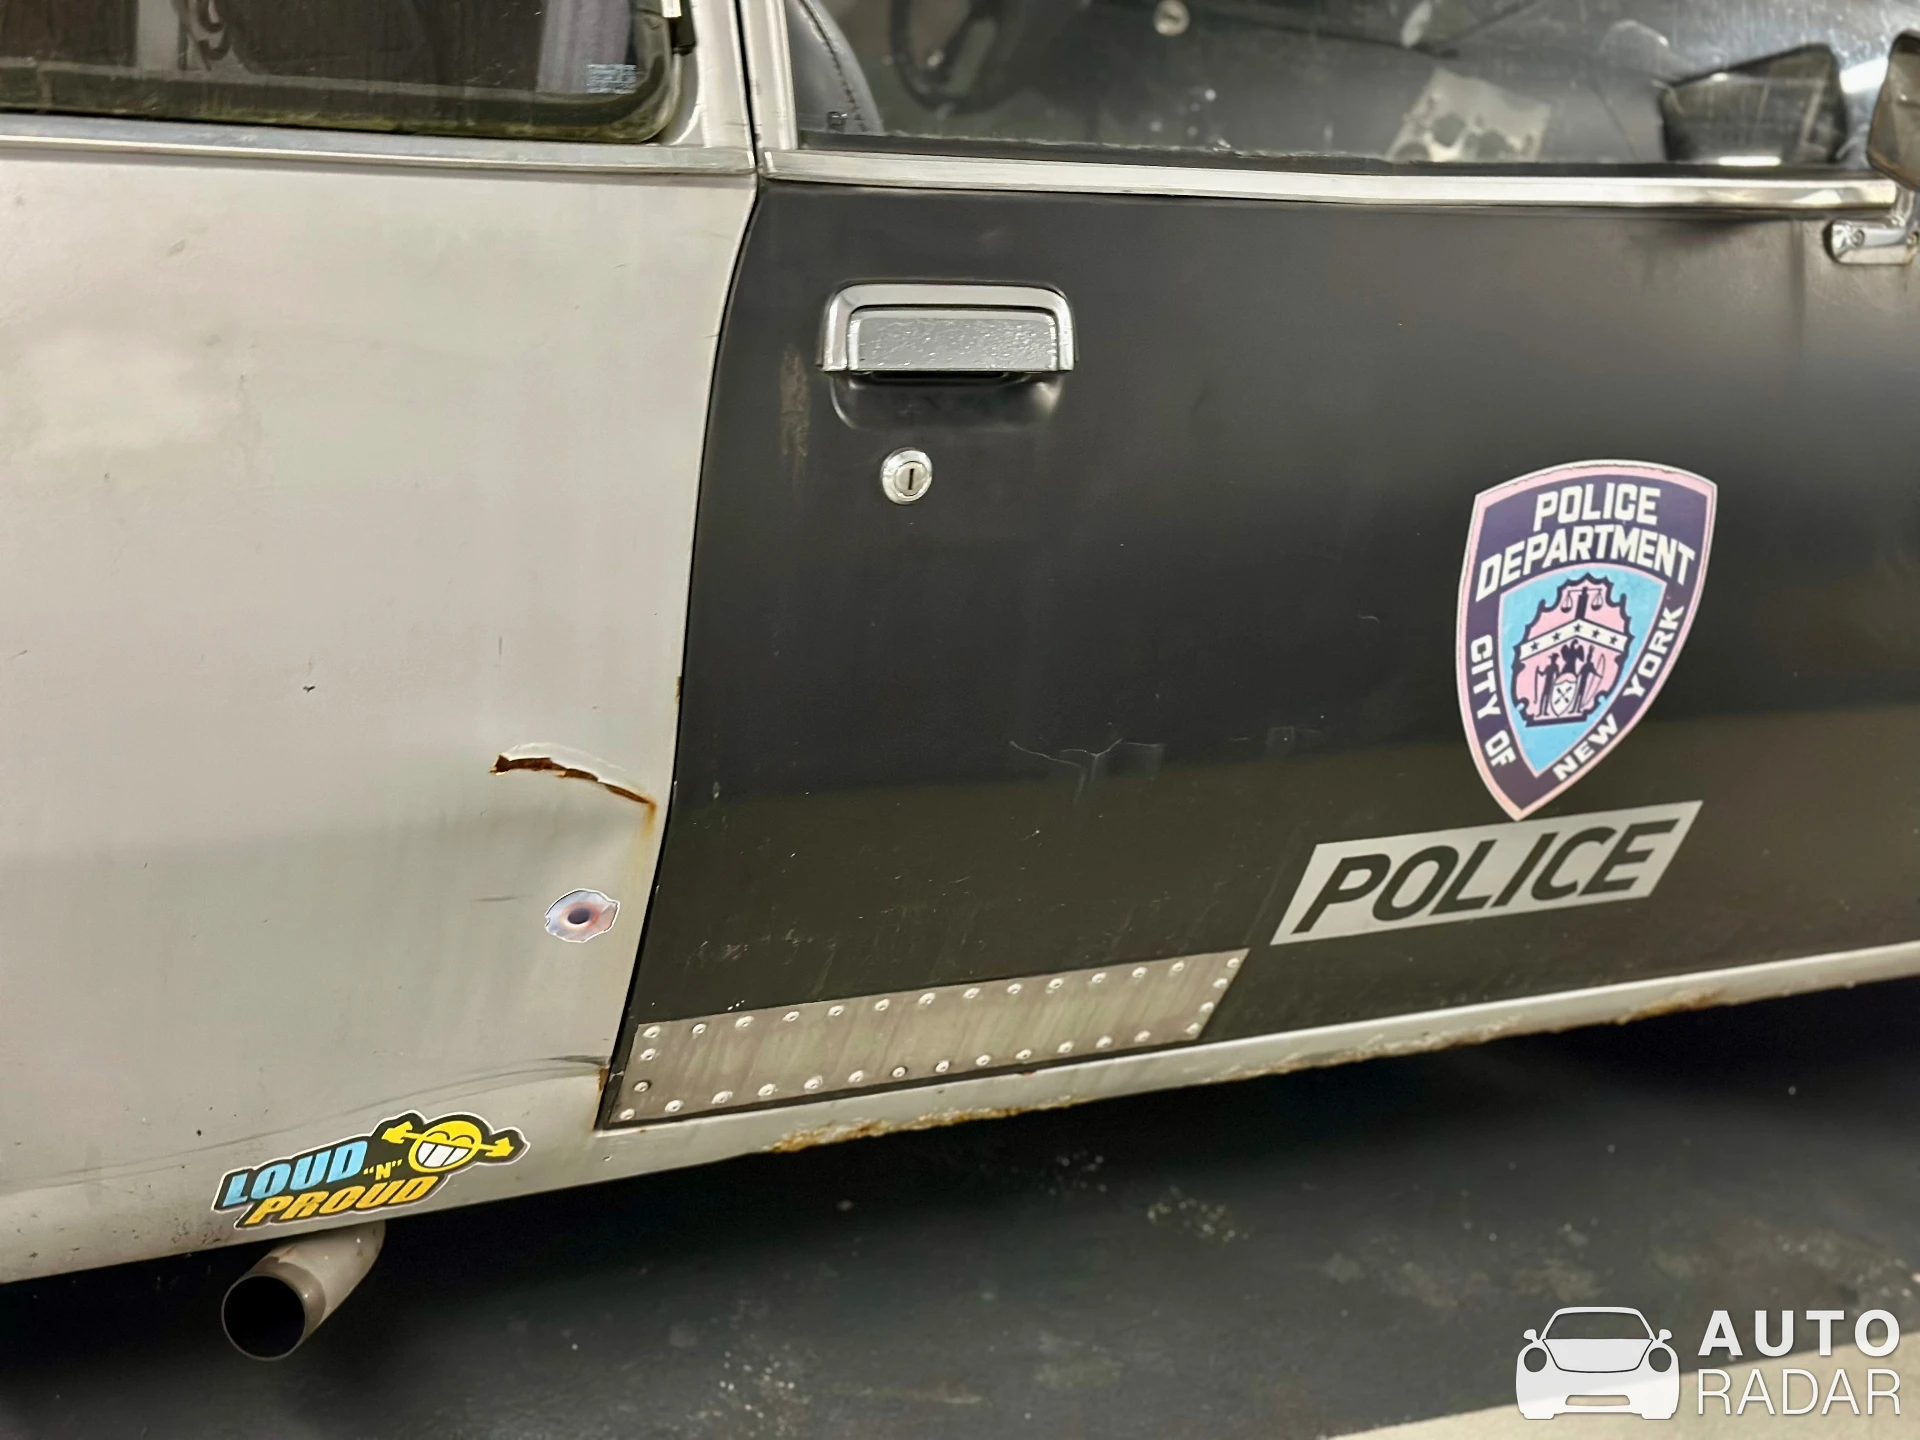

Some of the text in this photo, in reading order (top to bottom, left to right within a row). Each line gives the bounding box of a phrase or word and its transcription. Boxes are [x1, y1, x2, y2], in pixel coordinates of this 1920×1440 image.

[1534, 482, 1662, 532] POLICE
[1475, 524, 1696, 602] DEPARTMENT
[1470, 634, 1517, 767] CITY OF
[1552, 605, 1685, 781] NEW YORK
[1290, 818, 1681, 935] POLICE
[222, 1141, 368, 1207] LOUD
[244, 1176, 439, 1225] PROUD
